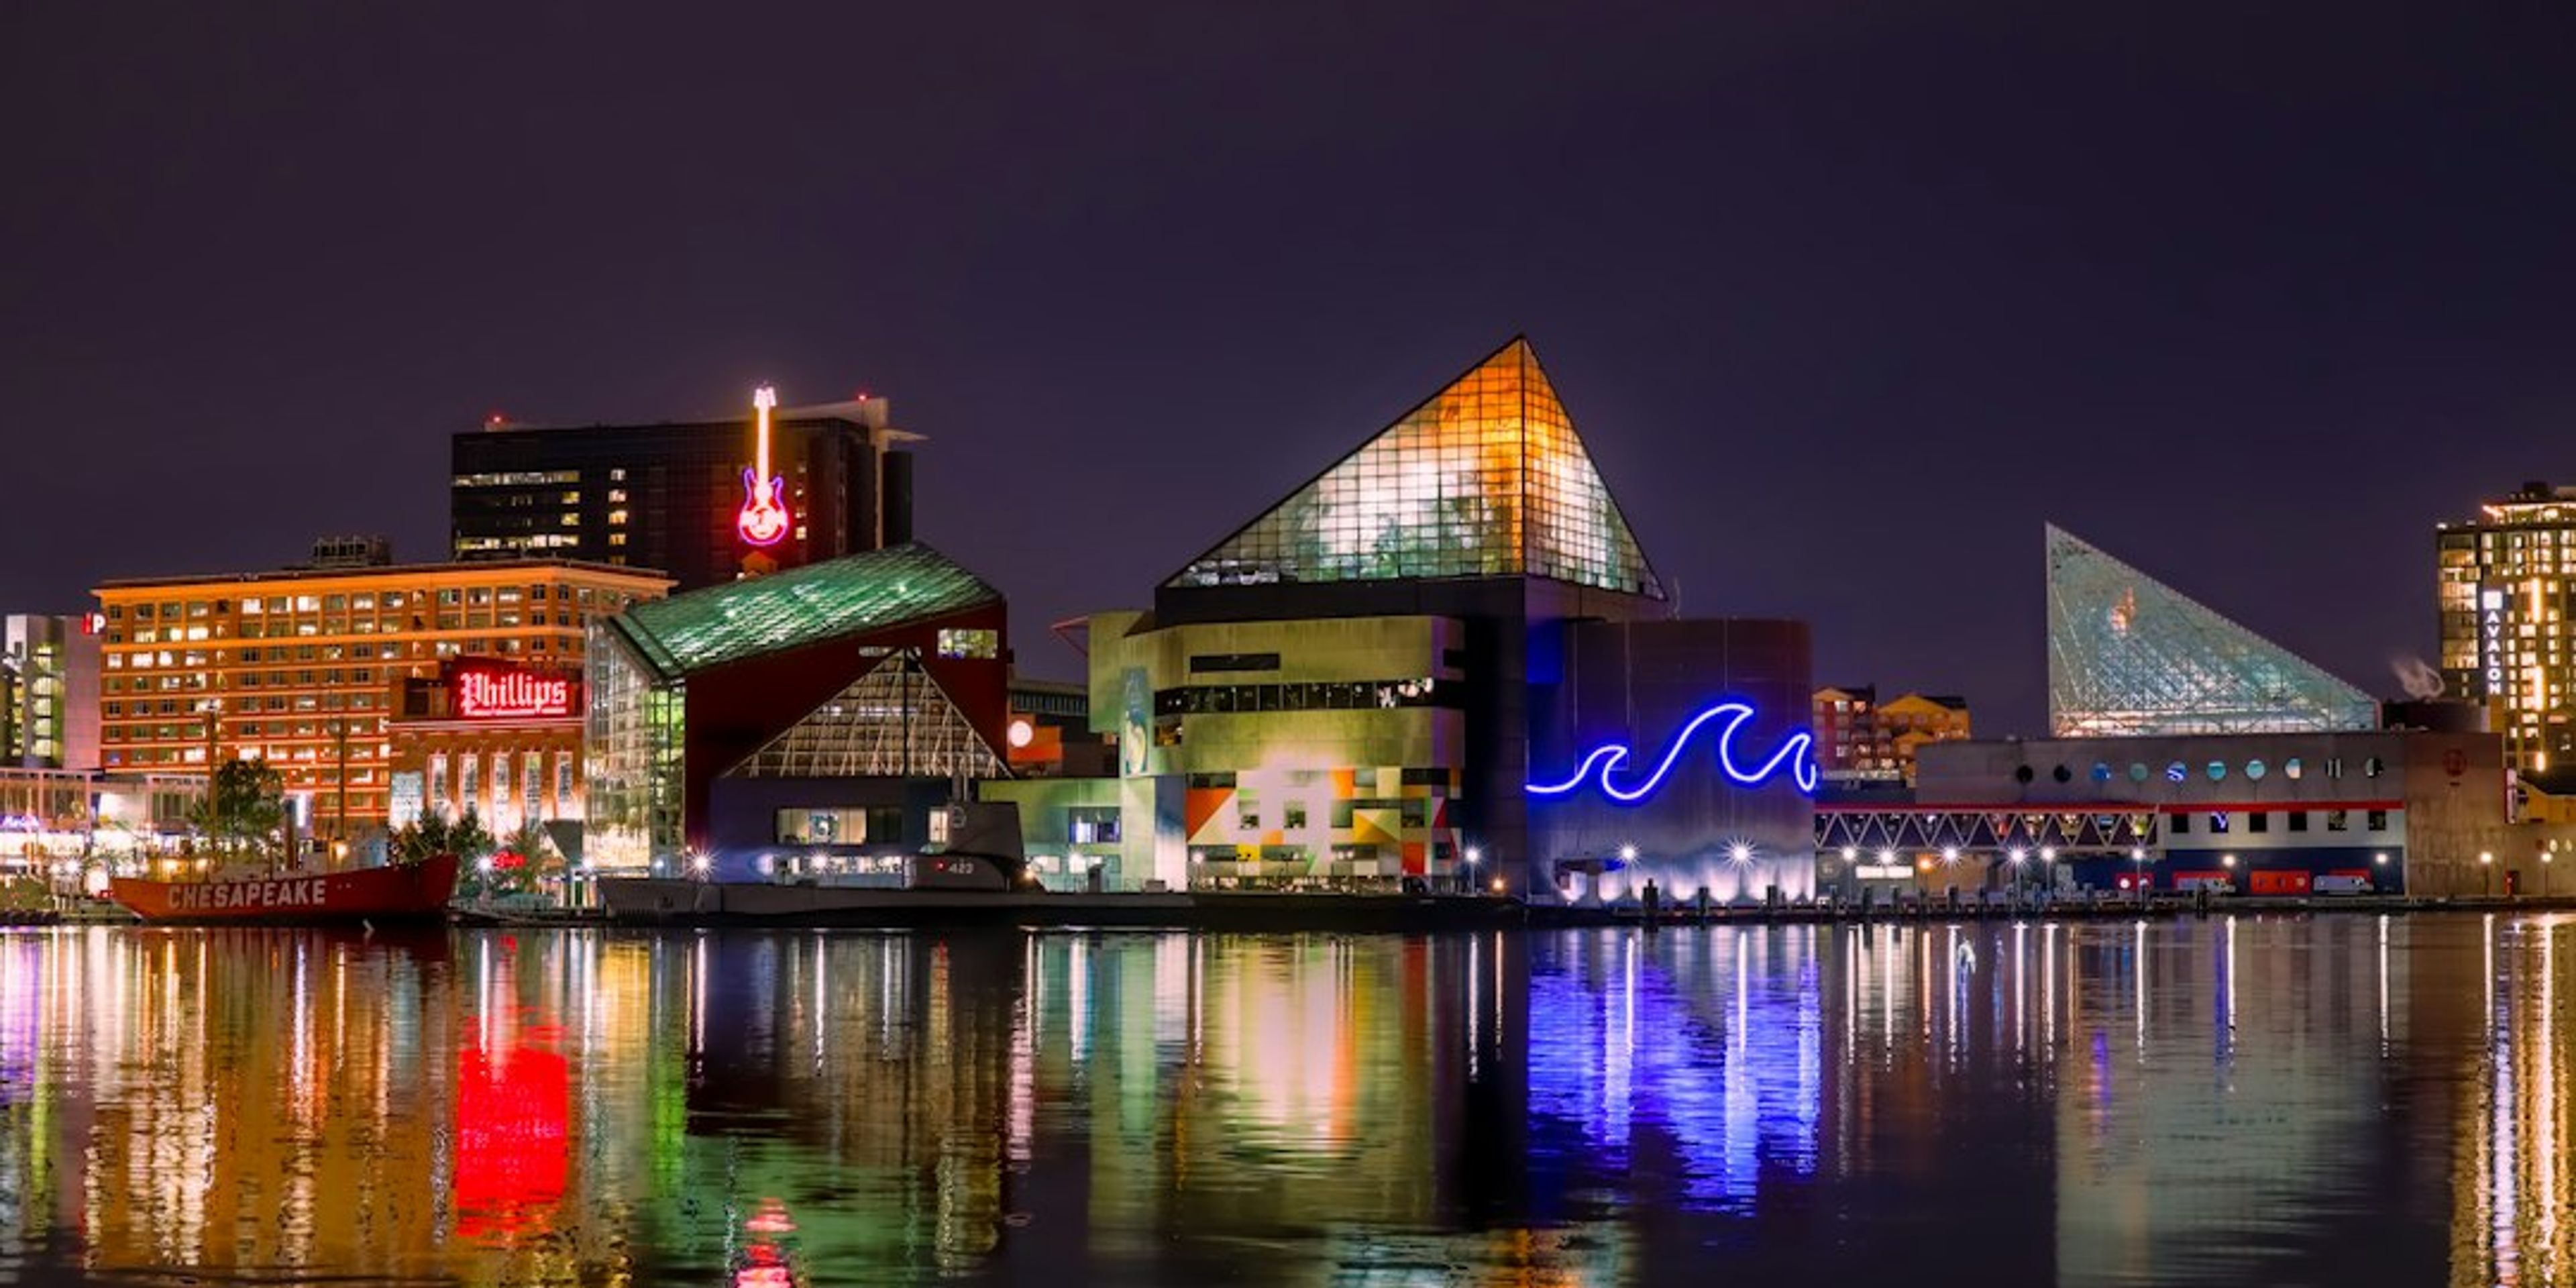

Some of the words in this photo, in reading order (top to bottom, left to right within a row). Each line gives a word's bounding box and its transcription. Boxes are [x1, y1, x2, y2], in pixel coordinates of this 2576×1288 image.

[2487, 610, 2502, 694] AVALON
[460, 672, 567, 716] Phillips
[168, 879, 327, 908] CHESAPEAKE
